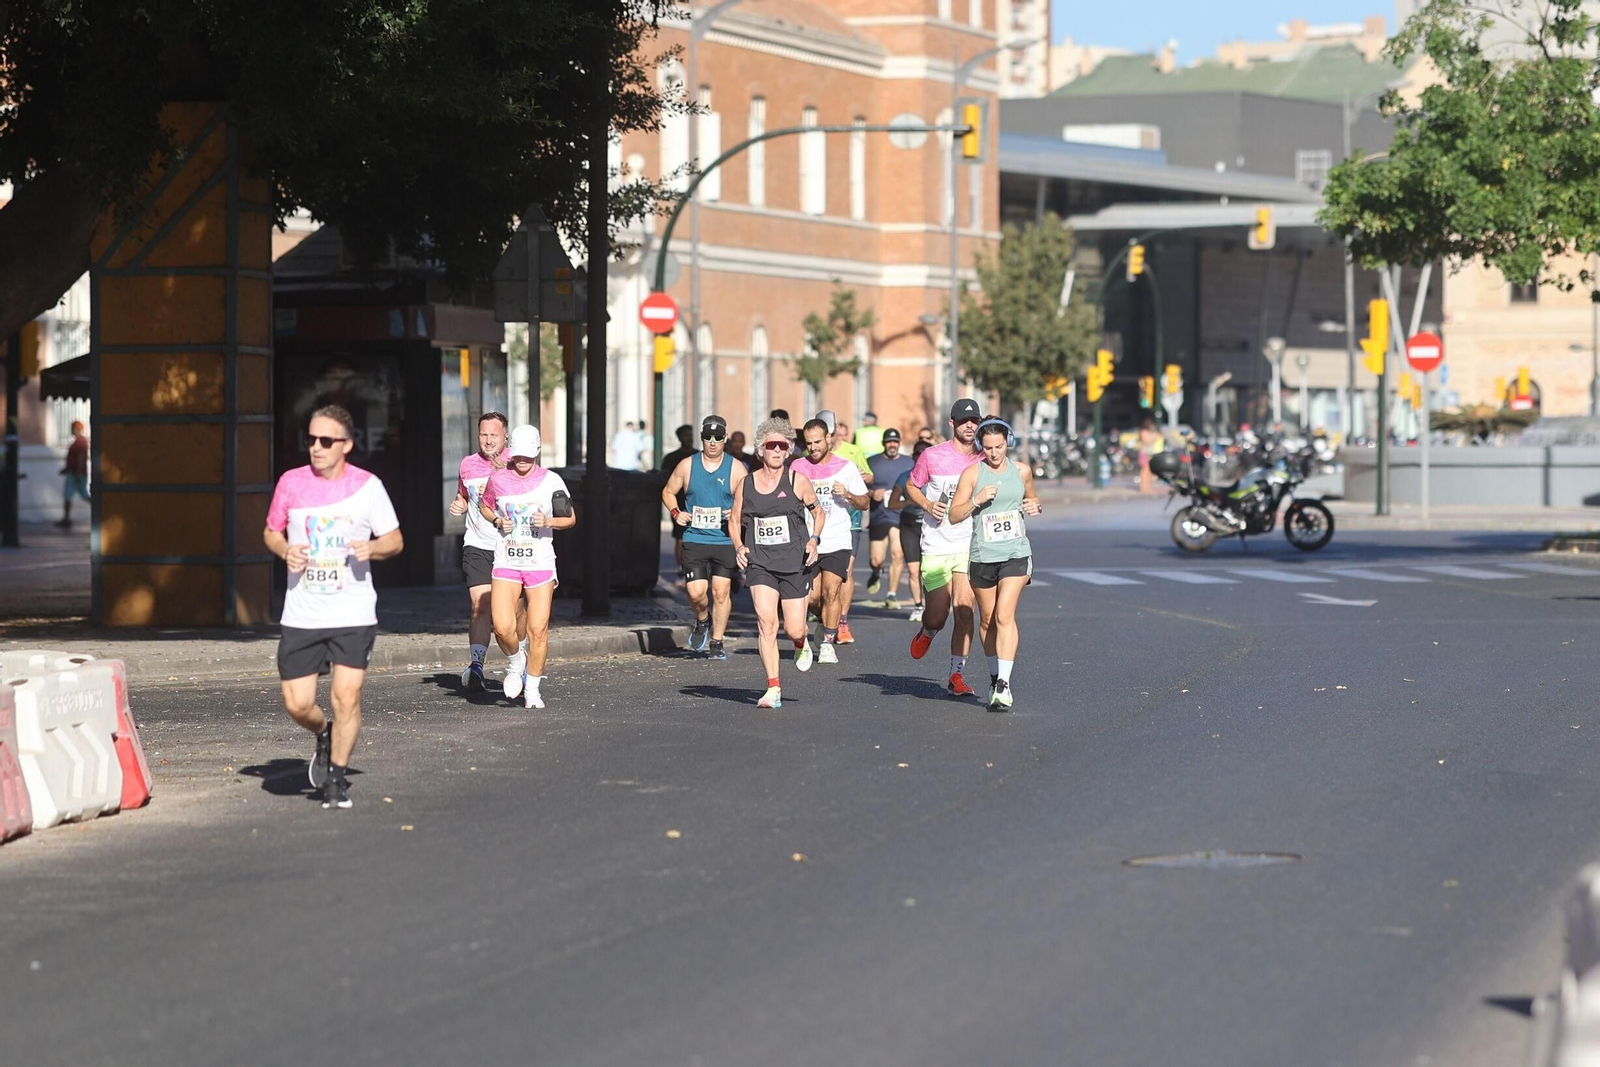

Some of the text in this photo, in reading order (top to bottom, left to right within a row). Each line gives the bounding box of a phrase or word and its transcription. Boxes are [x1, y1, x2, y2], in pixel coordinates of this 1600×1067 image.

[697, 514, 717, 523] 112
[758, 526, 783, 537] 682
[993, 521, 1012, 533] 28
[507, 547, 534, 558] 683
[306, 569, 338, 582] 684
